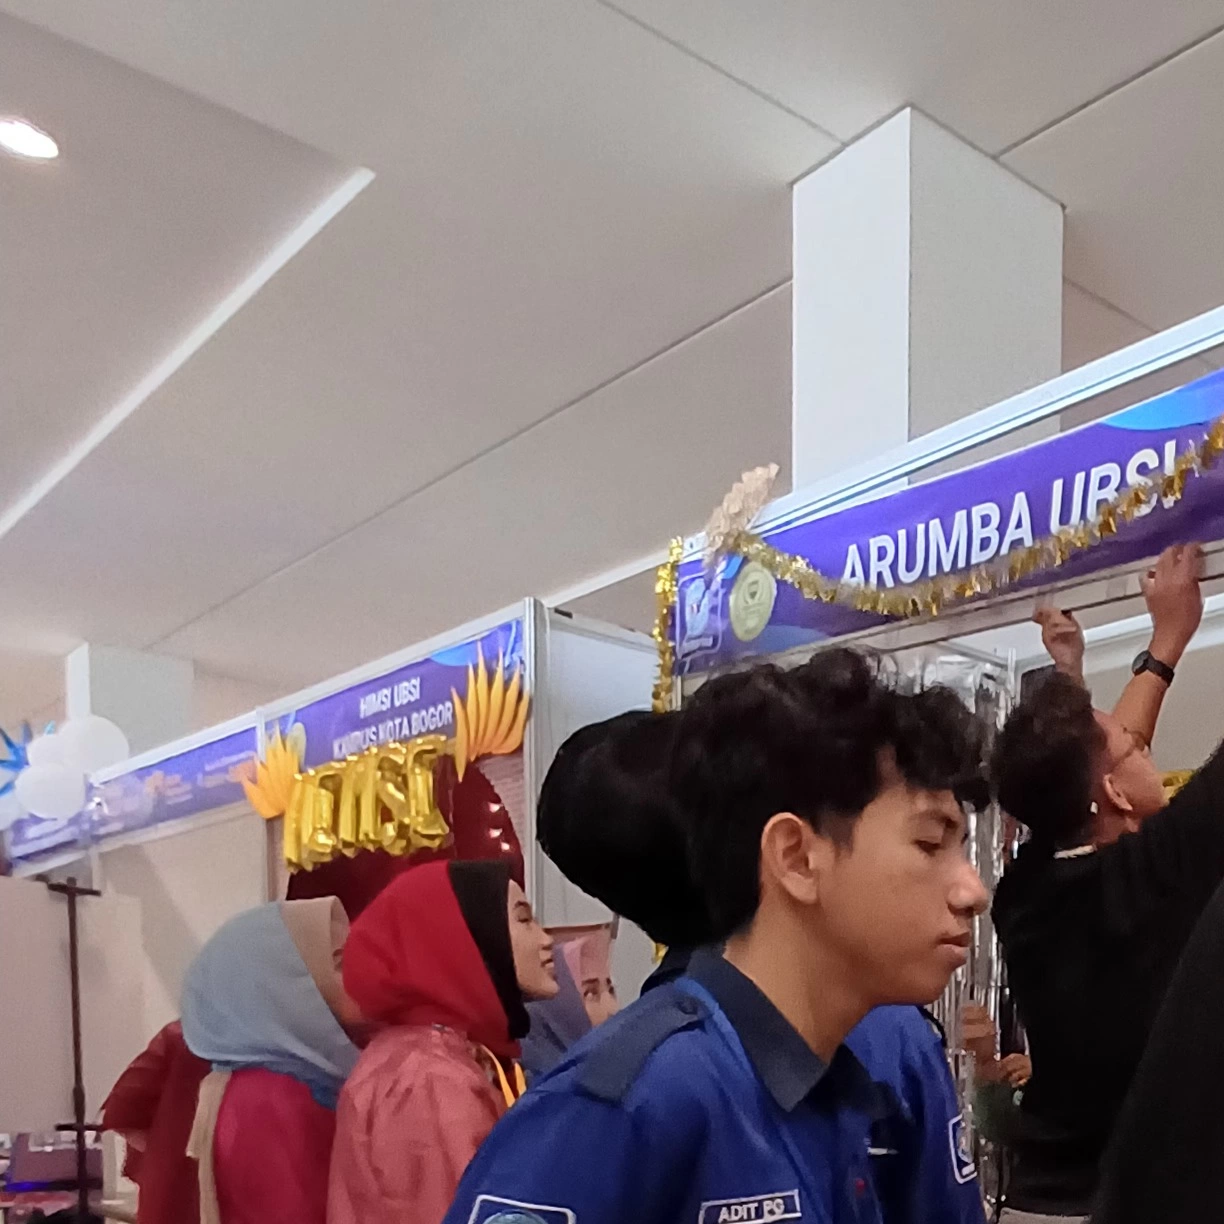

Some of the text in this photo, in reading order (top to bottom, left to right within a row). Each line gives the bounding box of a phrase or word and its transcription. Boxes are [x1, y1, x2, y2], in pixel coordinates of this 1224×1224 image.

[841, 491, 1034, 590] ARUMBA
[411, 700, 454, 736] BOGOR
[718, 1203, 758, 1224] ADIT
